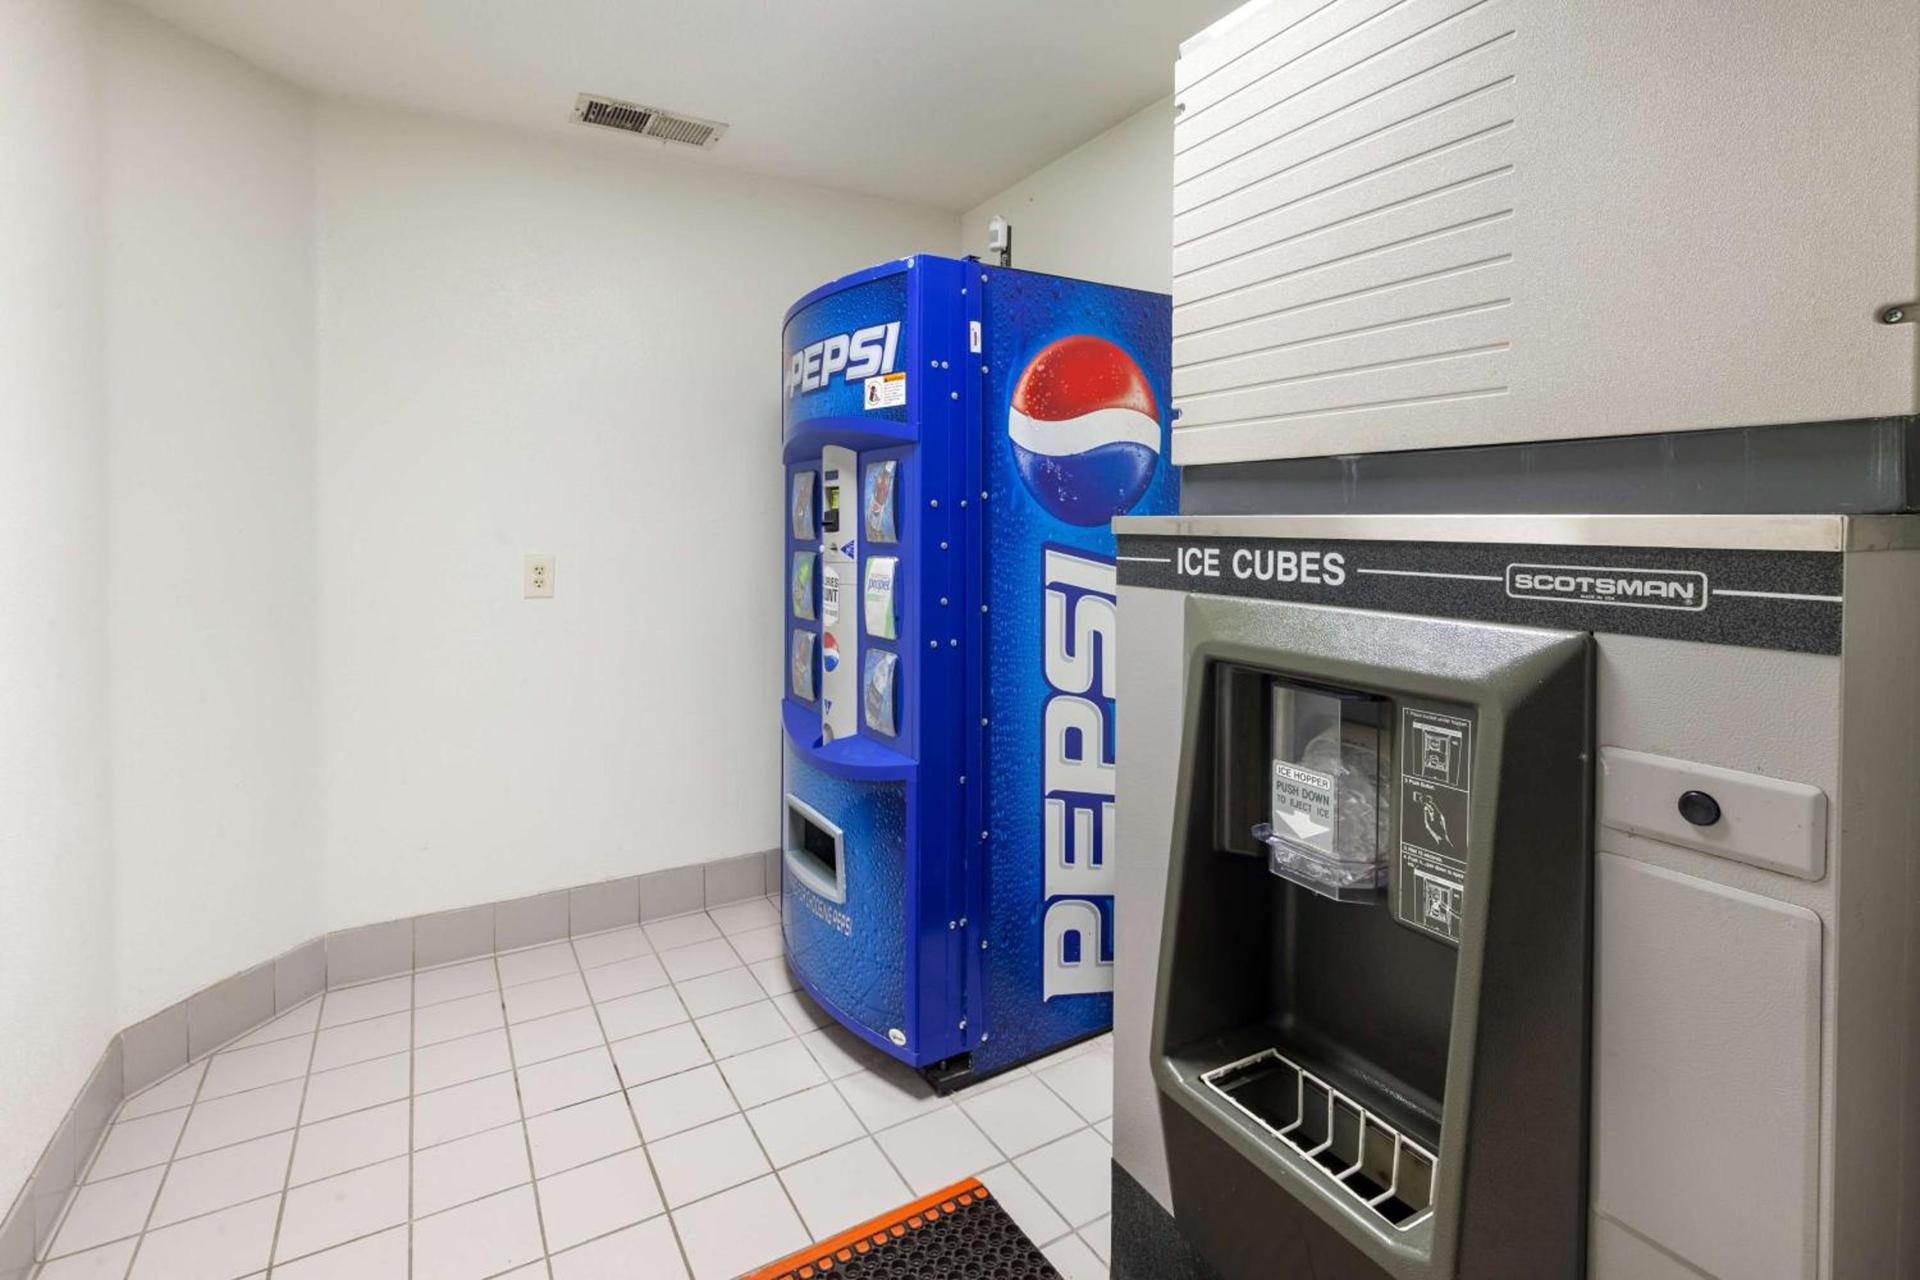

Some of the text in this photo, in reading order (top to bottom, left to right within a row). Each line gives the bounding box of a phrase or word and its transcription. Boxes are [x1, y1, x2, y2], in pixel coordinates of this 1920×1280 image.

[790, 321, 901, 399] PEPSI
[1177, 547, 1346, 586] ICE CUBES
[1514, 574, 1694, 599] SCOTSMAN
[1044, 550, 1116, 1003] PEPSI
[1278, 766, 1329, 788] ICE HOPPER
[1276, 780, 1330, 806] PUSH DOWN
[1276, 793, 1329, 819] TO EJECT ICE
